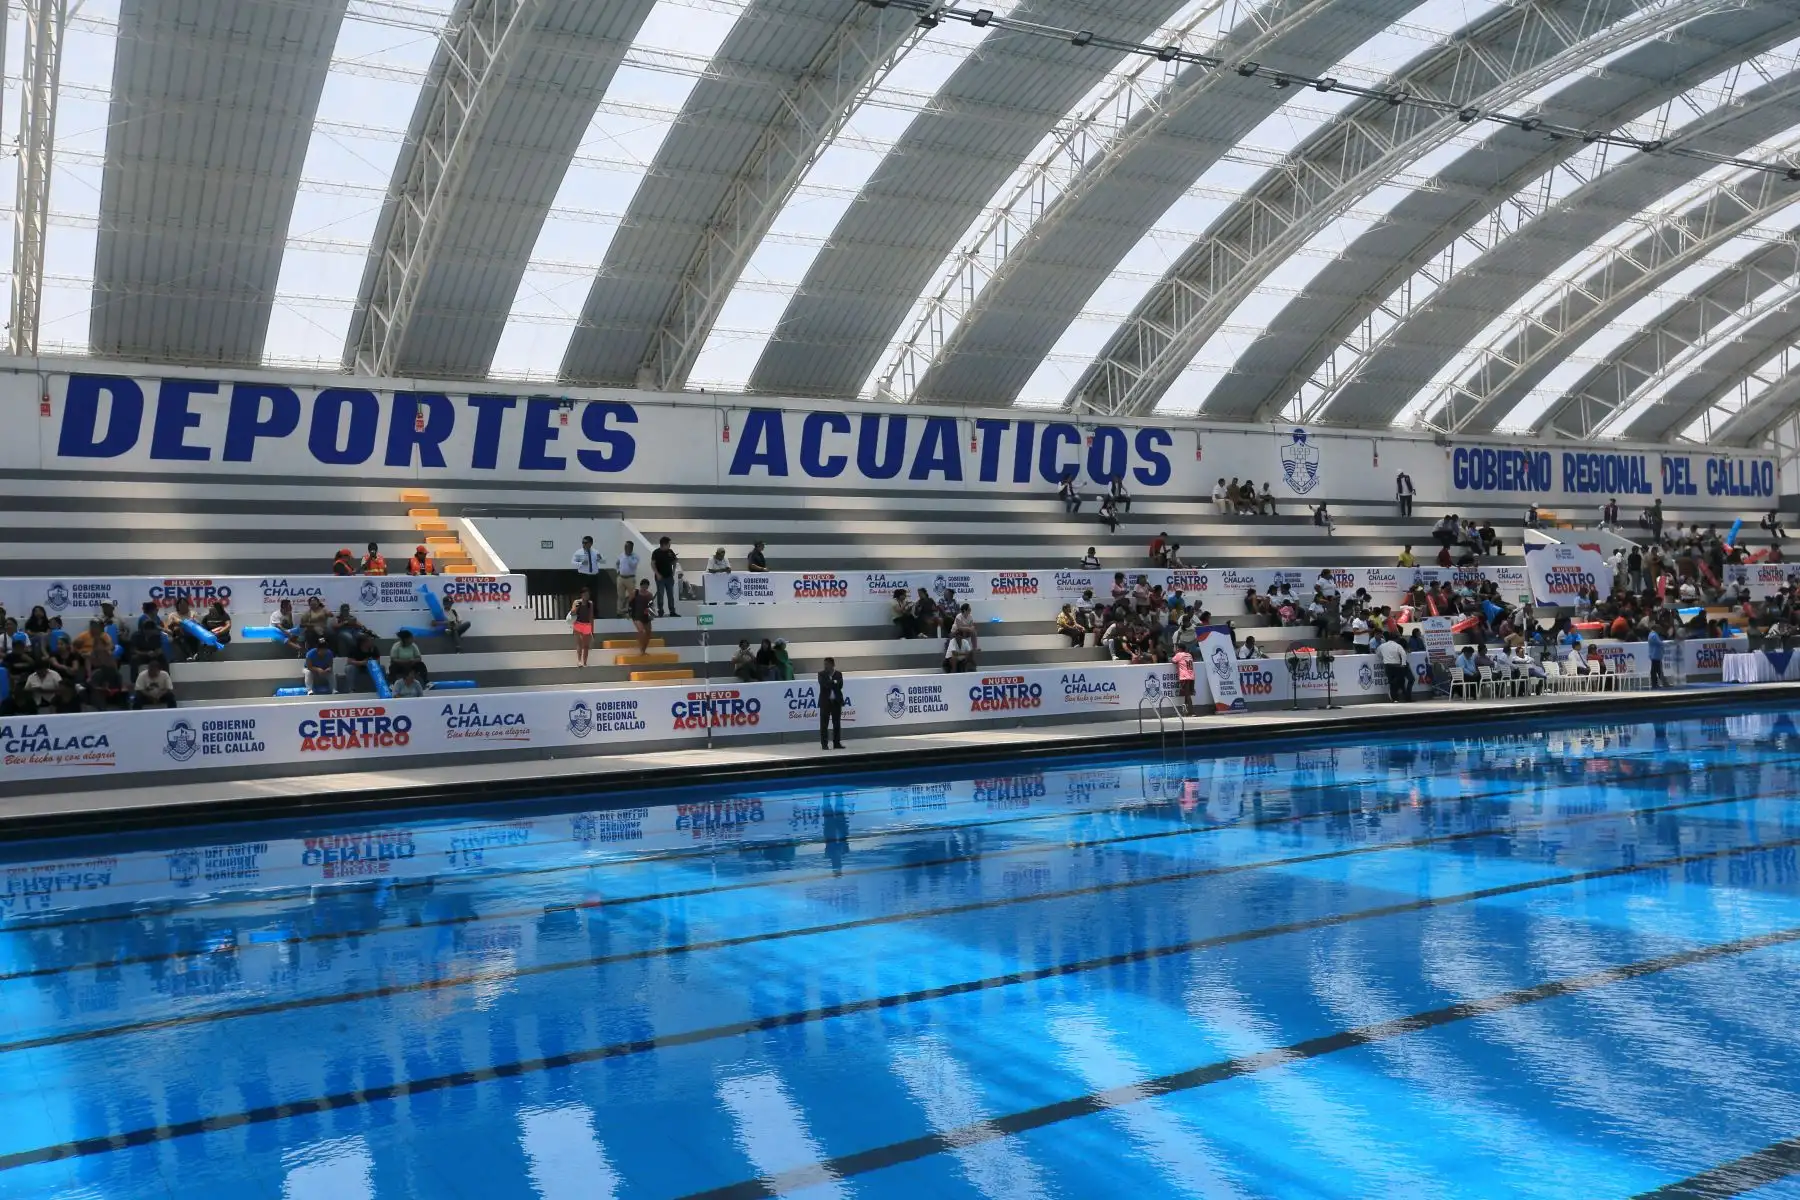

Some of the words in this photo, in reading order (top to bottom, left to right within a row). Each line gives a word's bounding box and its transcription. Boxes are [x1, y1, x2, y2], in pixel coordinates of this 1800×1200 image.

[57, 373, 639, 472] DEPORTES
[728, 407, 1172, 487] ACUATICOS
[1453, 447, 1551, 492] GOBIERNO
[1563, 451, 1652, 494] REGIONAL
[1662, 456, 1697, 496] DEL
[1706, 457, 1774, 497] CALLAO
[991, 577, 1039, 587] CENTRO
[1166, 575, 1208, 585] CENTRO
[1452, 572, 1486, 581] CENTRO
[1545, 573, 1595, 584] CENTRO
[260, 579, 268, 588] A
[272, 579, 288, 588] LA
[443, 582, 511, 595] CENTRO
[793, 580, 848, 591] CENTRO
[148, 586, 232, 599] CENTRO
[264, 588, 322, 597] CHALACA
[1061, 674, 1069, 684] A
[1072, 673, 1086, 683] LA
[784, 688, 794, 698] A
[798, 687, 815, 698] LA
[908, 685, 942, 694] GOBIERNO
[969, 683, 1042, 701] CENTRO
[1064, 682, 1117, 694] CHALACA
[908, 695, 942, 704] REGIONAL
[441, 704, 453, 716] A
[458, 703, 479, 715] LA
[596, 701, 638, 711] GOBIERNO
[671, 698, 761, 718] CENTRO
[909, 705, 922, 713] DEL
[923, 703, 949, 713] CALLAO
[329, 708, 376, 718] NUEVO
[596, 711, 637, 721] REGIONAL
[202, 719, 256, 731] GOBIERNO
[447, 713, 525, 728] CHALACA
[597, 723, 612, 731] DEL
[614, 721, 645, 731] CALLAO
[21, 724, 48, 738] LA
[298, 715, 412, 738] CENTRO
[202, 731, 255, 743] REGIONAL
[5, 735, 109, 753] CHALACA
[203, 744, 222, 755] DEL
[225, 742, 265, 753] CALLAO
